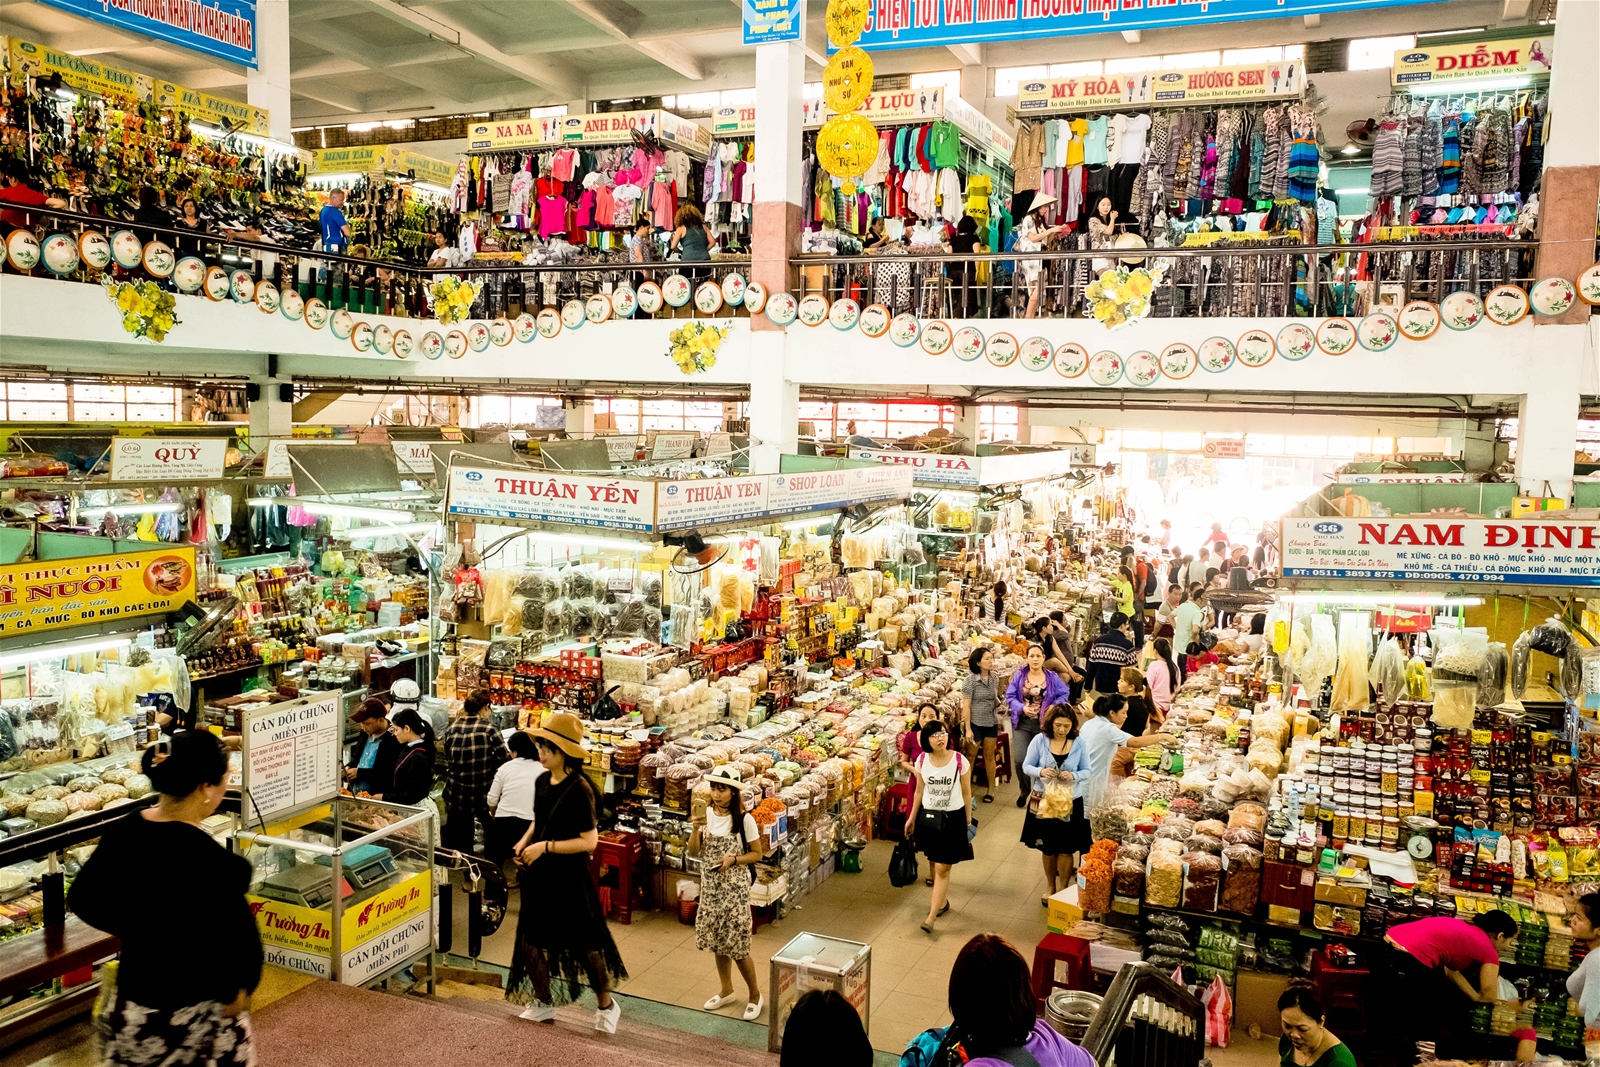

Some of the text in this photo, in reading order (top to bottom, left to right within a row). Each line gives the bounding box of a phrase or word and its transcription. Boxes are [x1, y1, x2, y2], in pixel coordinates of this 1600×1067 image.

[204, 3, 229, 42] KHÁCH
[231, 9, 252, 51] HÀNG
[842, 60, 854, 71] VẠN
[1436, 45, 1520, 72] DIỄM
[1052, 77, 1121, 98] MỸ HÒA
[1188, 69, 1265, 90] HƯƠNG SEN
[496, 124, 533, 138] NA NA
[584, 114, 636, 132] ANH ĐÀO
[155, 444, 201, 463] QUỲ
[936, 458, 971, 470] HÀ
[494, 478, 639, 504] THUẬN YẾN
[685, 482, 732, 503] THUẬN
[790, 476, 817, 491] SHOP
[1297, 520, 1338, 533] LÔ 36
[1358, 523, 1465, 546] NAM
[20, 558, 142, 581] THỰC PHẨM
[1508, 554, 1526, 562] MỰC
[1528, 554, 1545, 562] KHÔ
[1554, 555, 1572, 564] MỰC
[1528, 565, 1545, 573] KHÔ
[26, 575, 122, 602] NUÔI
[16, 600, 170, 628] CÁ MỰC BÒ KHÔ CÁC LOẠI
[252, 703, 334, 734] CÂN ĐỐI CHỨNG
[928, 776, 952, 785] Smile
[348, 920, 424, 969] CÂN ĐỐI CHỨNG
[288, 956, 325, 974] CHỨNG
